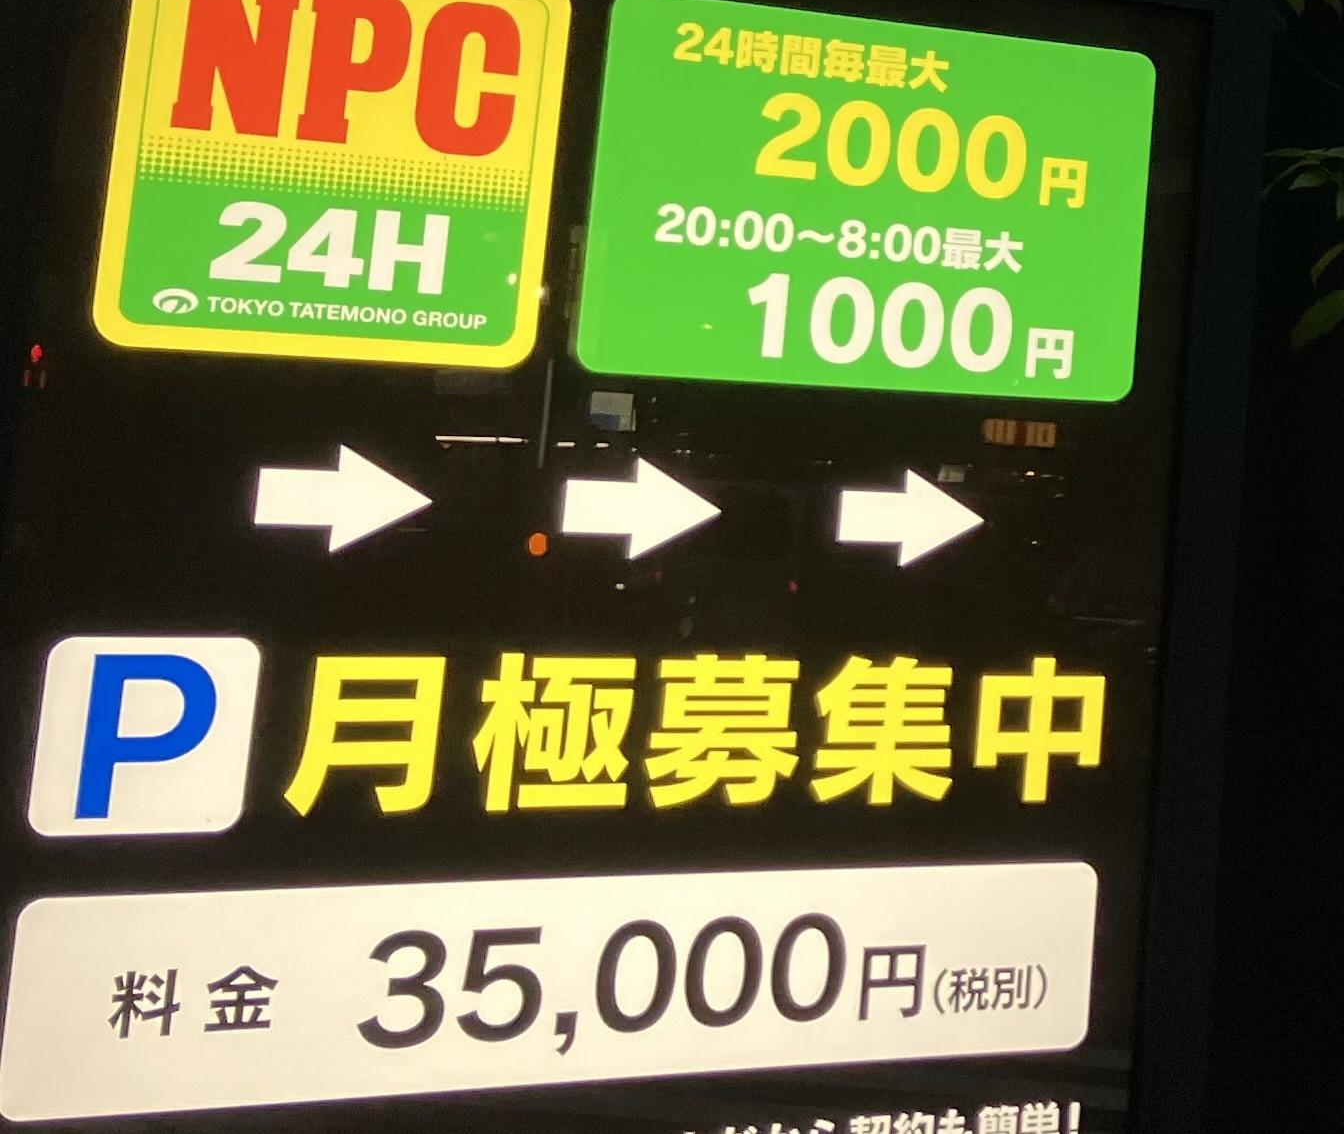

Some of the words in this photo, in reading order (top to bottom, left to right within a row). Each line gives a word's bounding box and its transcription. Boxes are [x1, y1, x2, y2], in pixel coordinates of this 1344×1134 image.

[672, 22, 951, 94] 24時間毎最大
[209, 201, 450, 295] 24H
[207, 296, 285, 317] TOKYO
[289, 301, 407, 325] TATEMONO
[412, 310, 487, 330] GROUP
[75, 654, 217, 820] P
[283, 652, 1107, 817] 月極募集中
[110, 969, 280, 1039] 料金
